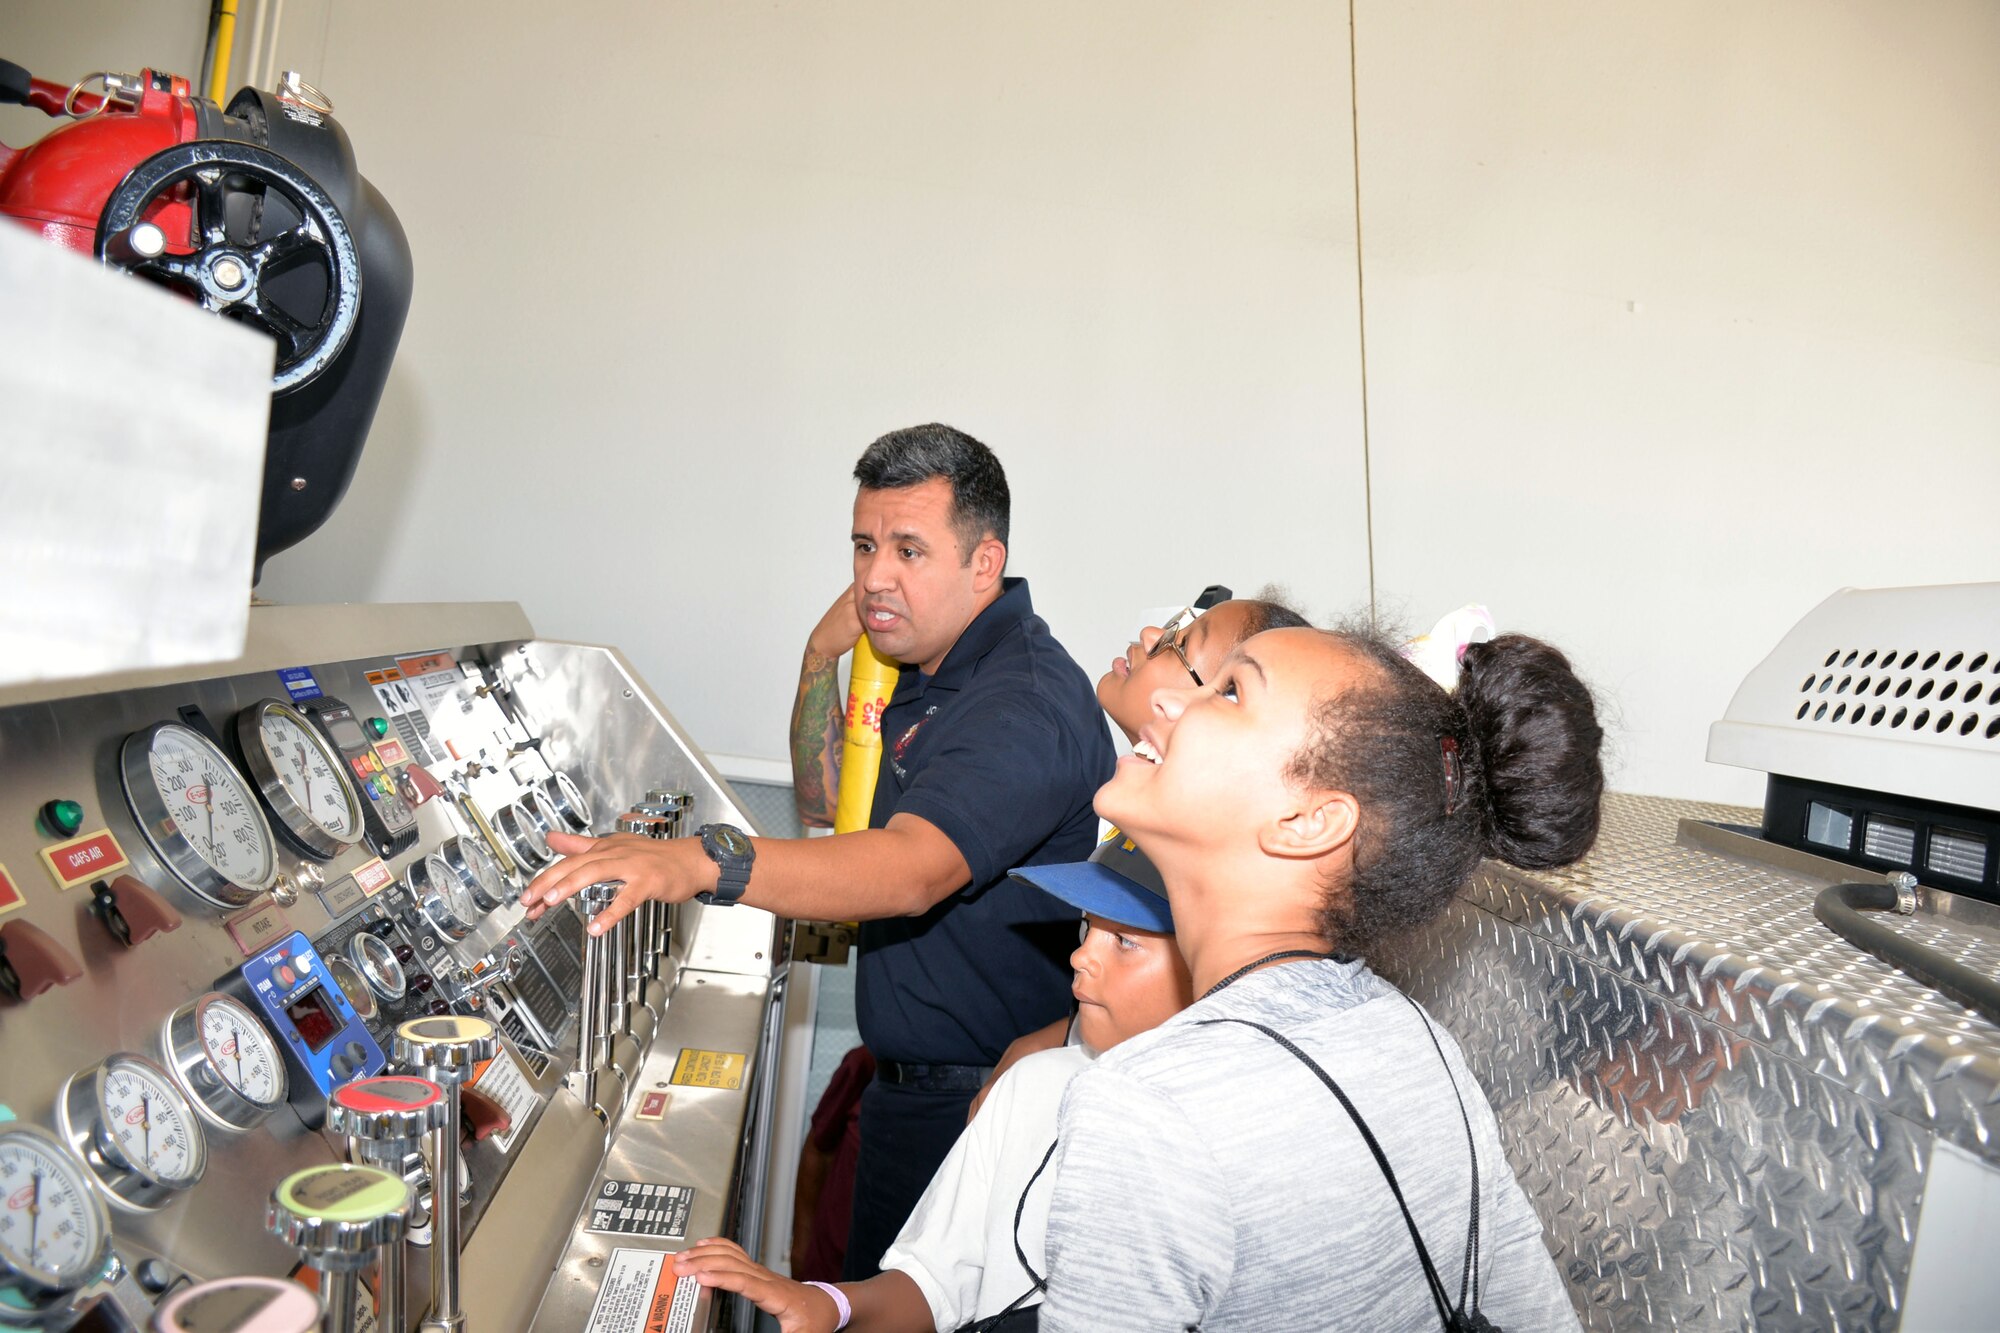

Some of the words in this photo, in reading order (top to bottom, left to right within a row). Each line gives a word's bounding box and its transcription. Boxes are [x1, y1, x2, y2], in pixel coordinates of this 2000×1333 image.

[862, 702, 874, 726] NO
[873, 697, 886, 733] STEP
[178, 760, 194, 774] 300
[168, 775, 186, 791] 200
[202, 772, 218, 786] 400
[179, 806, 197, 822] 100
[220, 801, 238, 816] 500
[234, 828, 250, 843] 600
[69, 850, 91, 867] CAFS
[88, 846, 104, 860] AIR
[252, 917, 272, 934] INTAKE
[257, 978, 272, 994] FOAM
[213, 1022, 224, 1033] 300
[208, 1038, 220, 1050] 200
[244, 1046, 254, 1056] 500
[253, 1065, 262, 1076] 600
[118, 1086, 130, 1099] 300
[111, 1105, 124, 1118] 200
[156, 1112, 168, 1125] 500
[120, 1130, 132, 1144] 100
[164, 1134, 176, 1148] 600
[49, 1192, 64, 1208] 500
[58, 1220, 74, 1236] 600
[653, 1294, 670, 1322] WARNING
